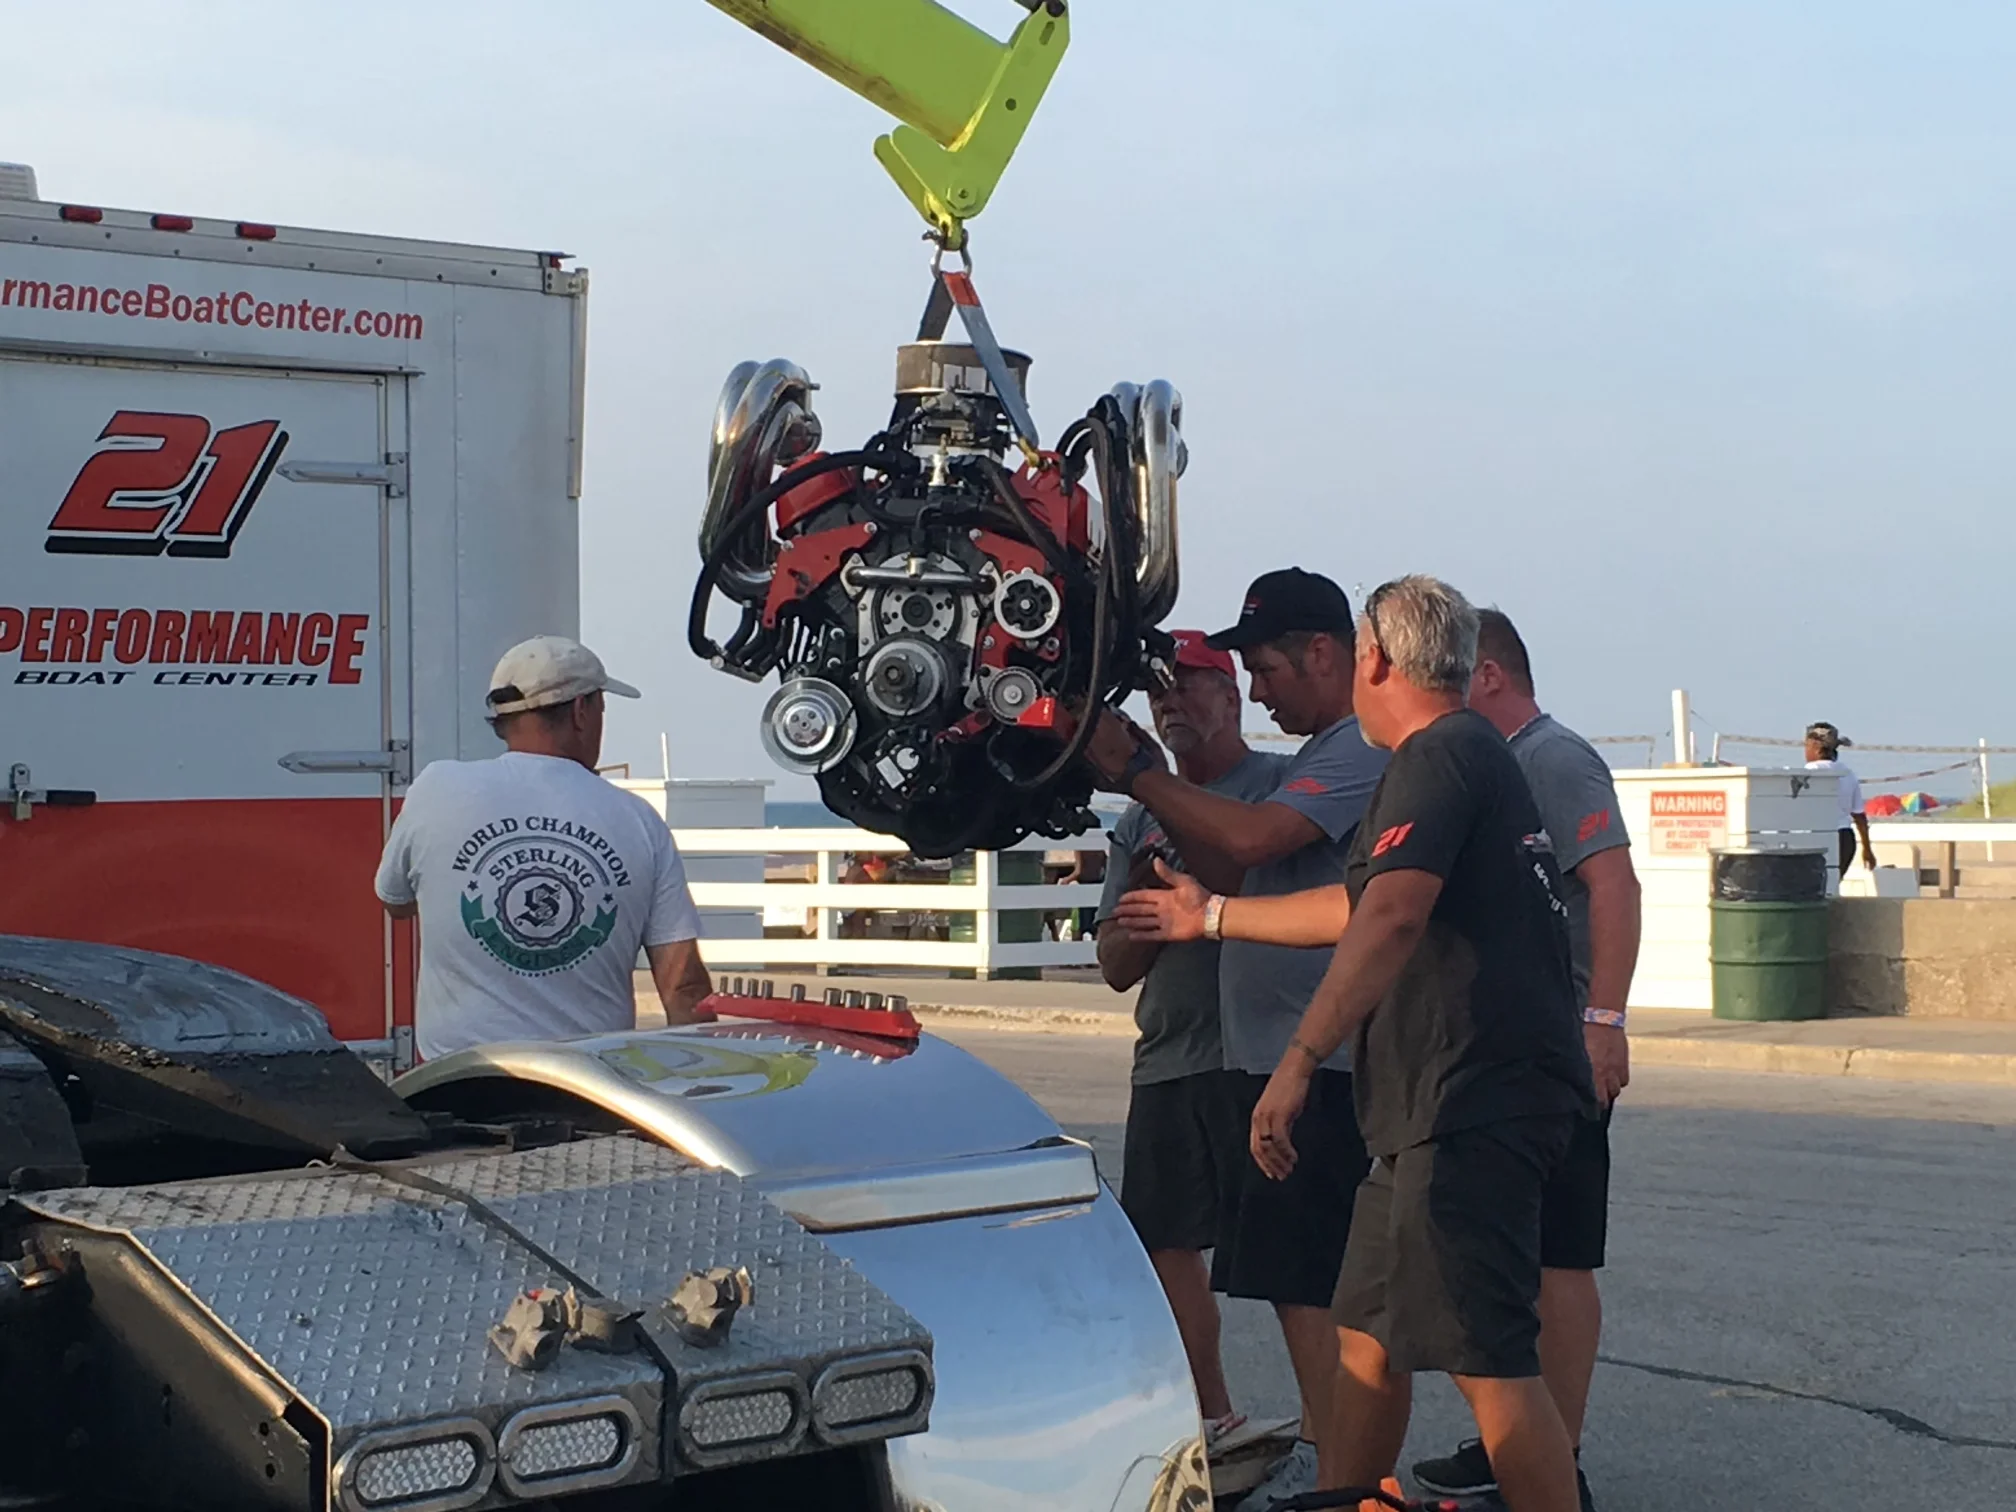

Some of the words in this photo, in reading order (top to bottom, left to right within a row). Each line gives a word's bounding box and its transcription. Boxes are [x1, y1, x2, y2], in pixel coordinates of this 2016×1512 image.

[44, 410, 289, 559] 21
[14, 671, 137, 686] BOAT
[152, 671, 319, 687] CENTER
[1653, 795, 1724, 813] WARNING
[452, 816, 520, 874] WORLD
[525, 816, 632, 888] CHAMPION
[1371, 821, 1415, 857] 21
[489, 848, 596, 890] STERLING
